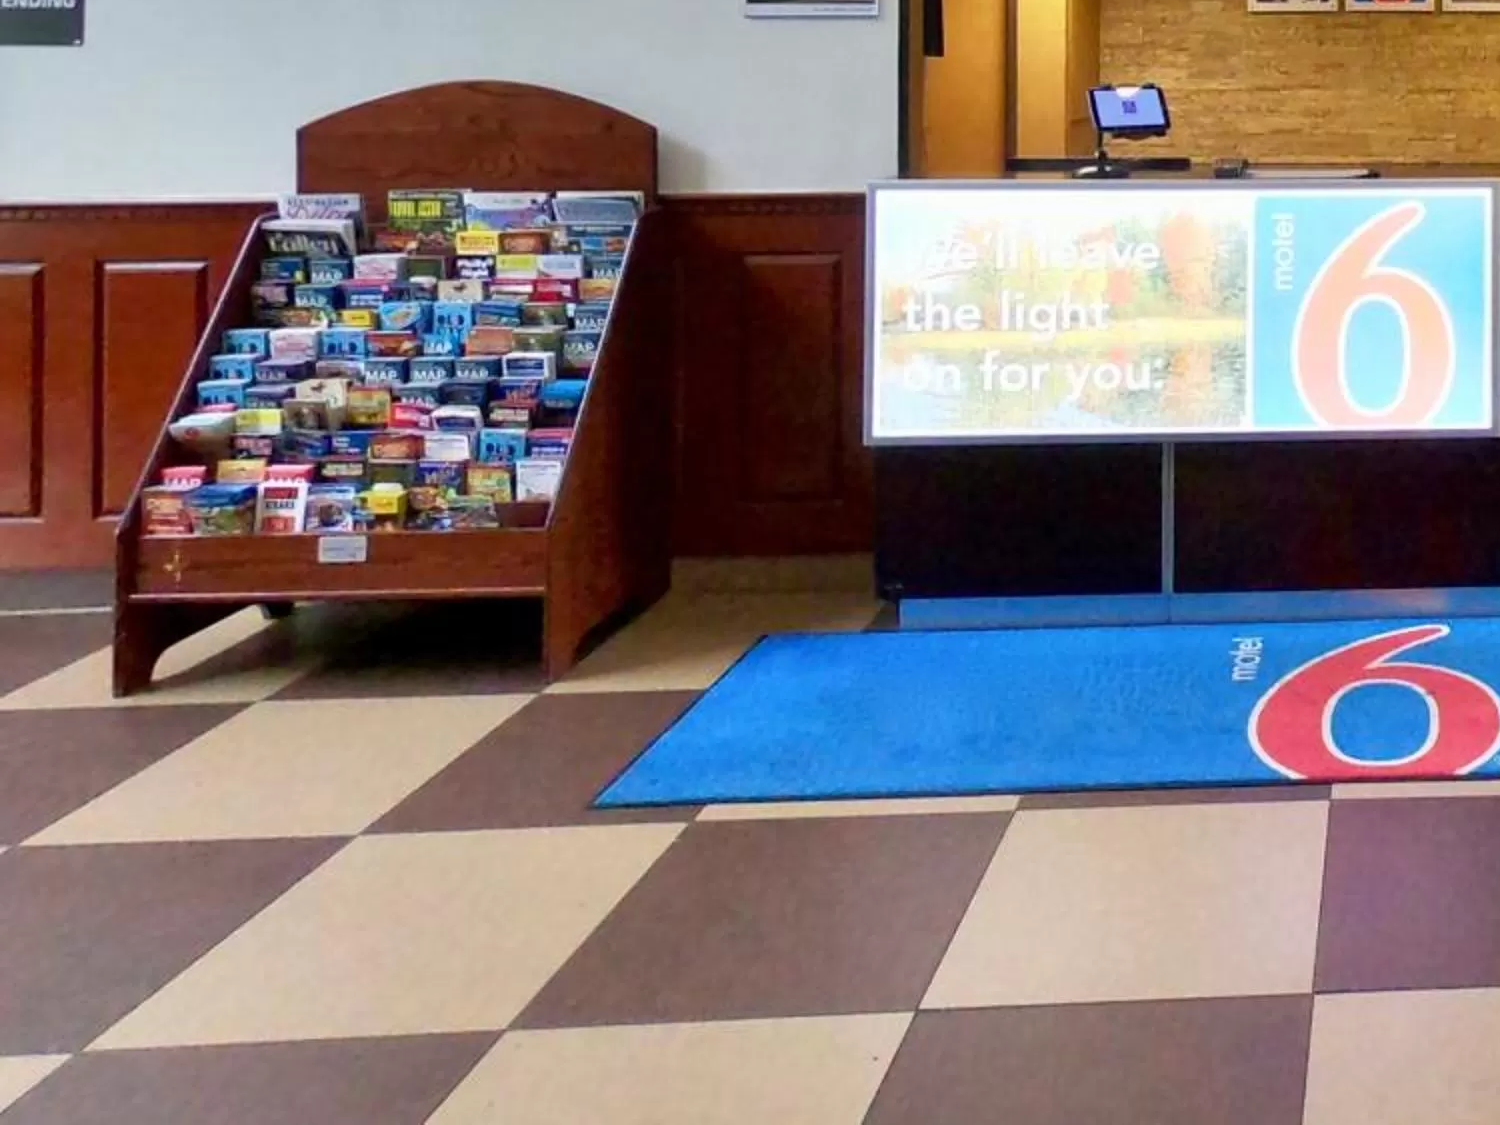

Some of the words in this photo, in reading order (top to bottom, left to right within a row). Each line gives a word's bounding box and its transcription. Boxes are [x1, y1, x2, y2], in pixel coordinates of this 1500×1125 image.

[1271, 212, 1295, 291] motel
[904, 290, 981, 332] the
[1001, 290, 1110, 341] light
[1290, 200, 1456, 428] 6
[366, 370, 398, 381] MAP
[414, 370, 447, 381] MAP
[904, 361, 961, 393] on
[980, 350, 1050, 393] for
[1229, 636, 1264, 682] motel
